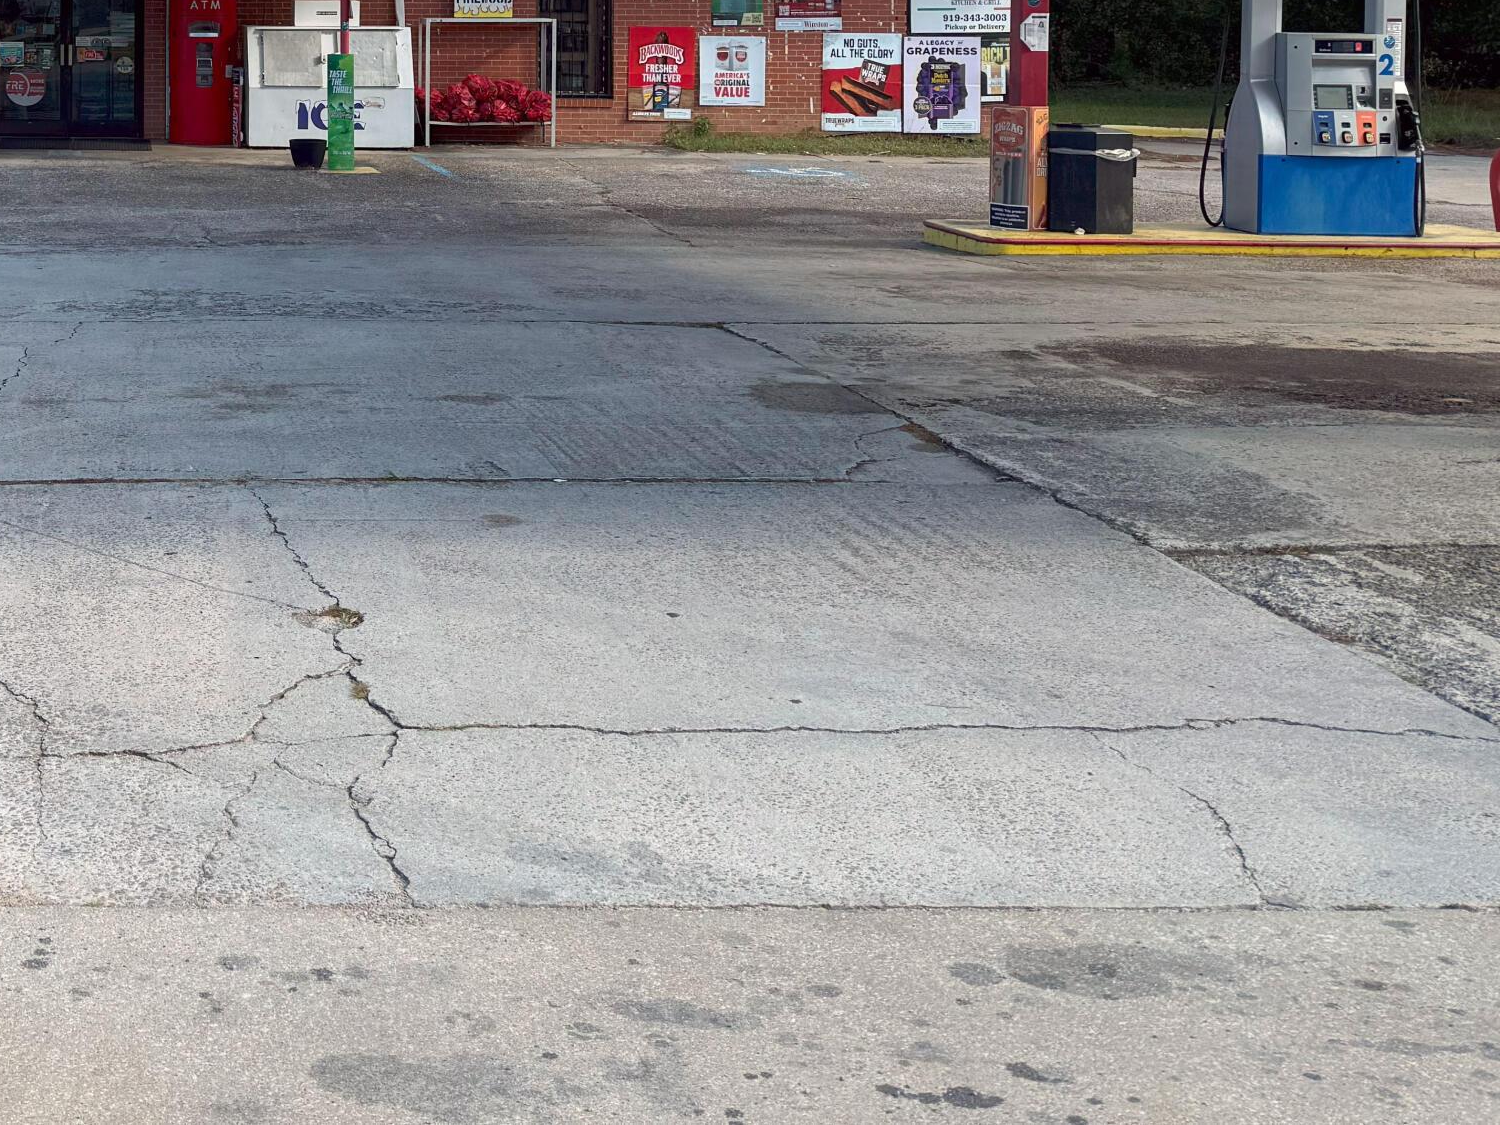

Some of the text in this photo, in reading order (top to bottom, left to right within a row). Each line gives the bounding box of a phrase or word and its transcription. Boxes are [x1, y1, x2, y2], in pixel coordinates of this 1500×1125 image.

[190, 0, 221, 10] ATM
[943, 14, 1007, 22] 919-343-3003
[844, 38, 880, 48] NO GUTS,
[639, 43, 684, 64] BACKWOODS
[830, 49, 894, 58] ALL THE GLORY
[906, 47, 978, 55] GRAPENESS
[981, 47, 1004, 63] RICH
[645, 64, 678, 73] FRESHER
[867, 63, 885, 74] TRUE
[1378, 54, 1394, 75] 2
[329, 70, 347, 78] TASTE
[642, 73, 682, 83] THAN EVER
[861, 69, 887, 82] WRAPS
[331, 78, 342, 86] THE
[714, 79, 750, 87] ORIGINAL
[332, 85, 352, 94] THRILL
[714, 86, 750, 98] VALUE
[994, 122, 1024, 135] ZIGZAG
